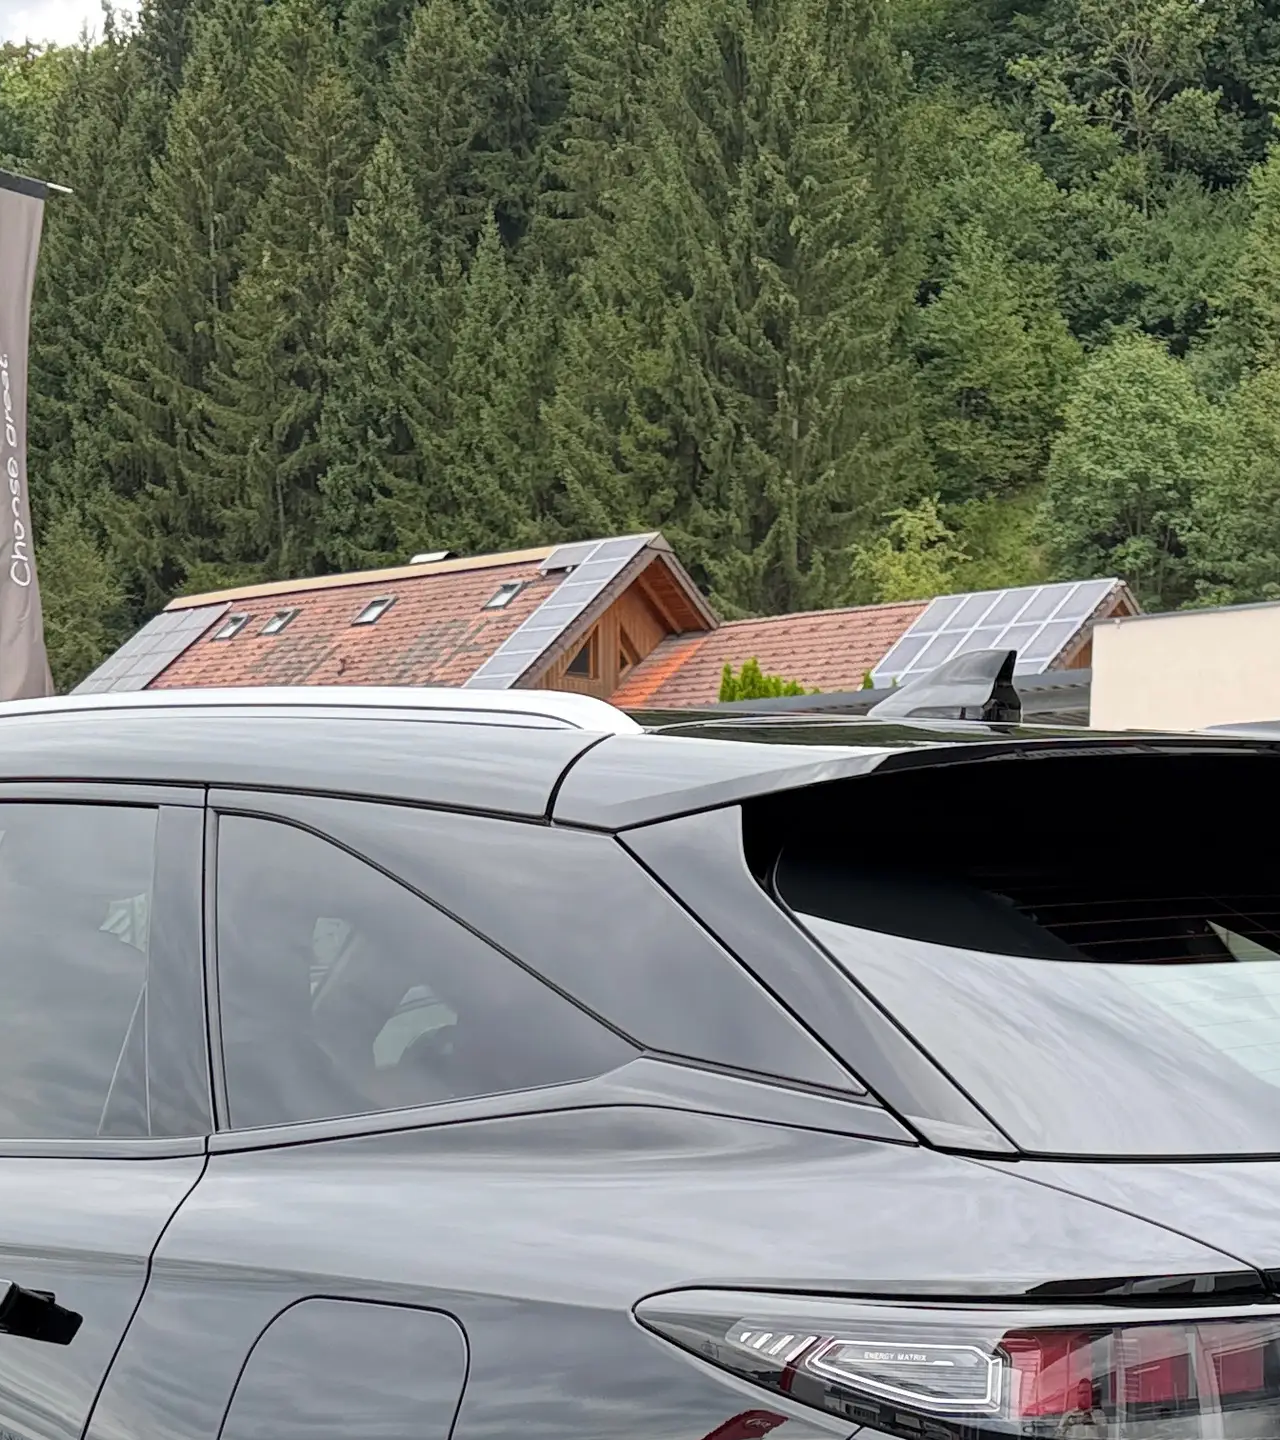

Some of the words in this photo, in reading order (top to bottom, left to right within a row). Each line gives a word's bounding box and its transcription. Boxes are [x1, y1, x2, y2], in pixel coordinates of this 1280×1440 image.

[7, 456, 32, 587] Choose
[863, 1351, 895, 1361] ENERGY
[897, 1352, 928, 1362] MATRIX
